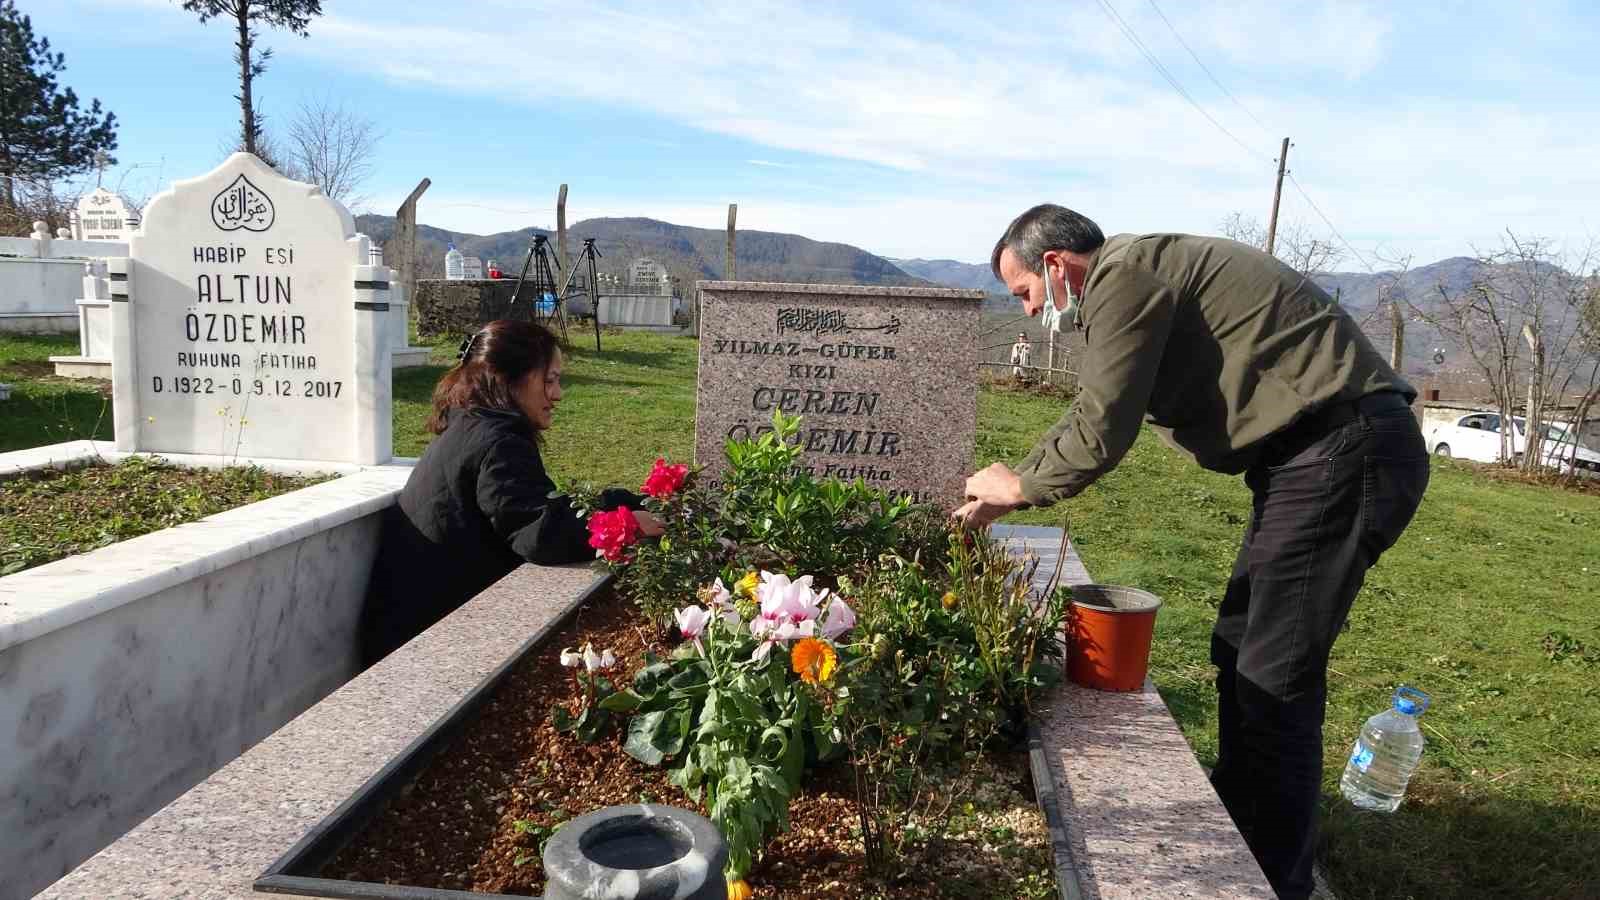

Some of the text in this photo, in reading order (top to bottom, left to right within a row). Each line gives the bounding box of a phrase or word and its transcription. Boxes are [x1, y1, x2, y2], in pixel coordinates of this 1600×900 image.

[193, 242, 246, 264] HABİP
[198, 274, 291, 304] ALTUN
[186, 307, 306, 344] ÖZDEMİR
[177, 352, 241, 368] RUHUNA
[788, 364, 837, 379] KIZI
[752, 387, 880, 416] CEREN
